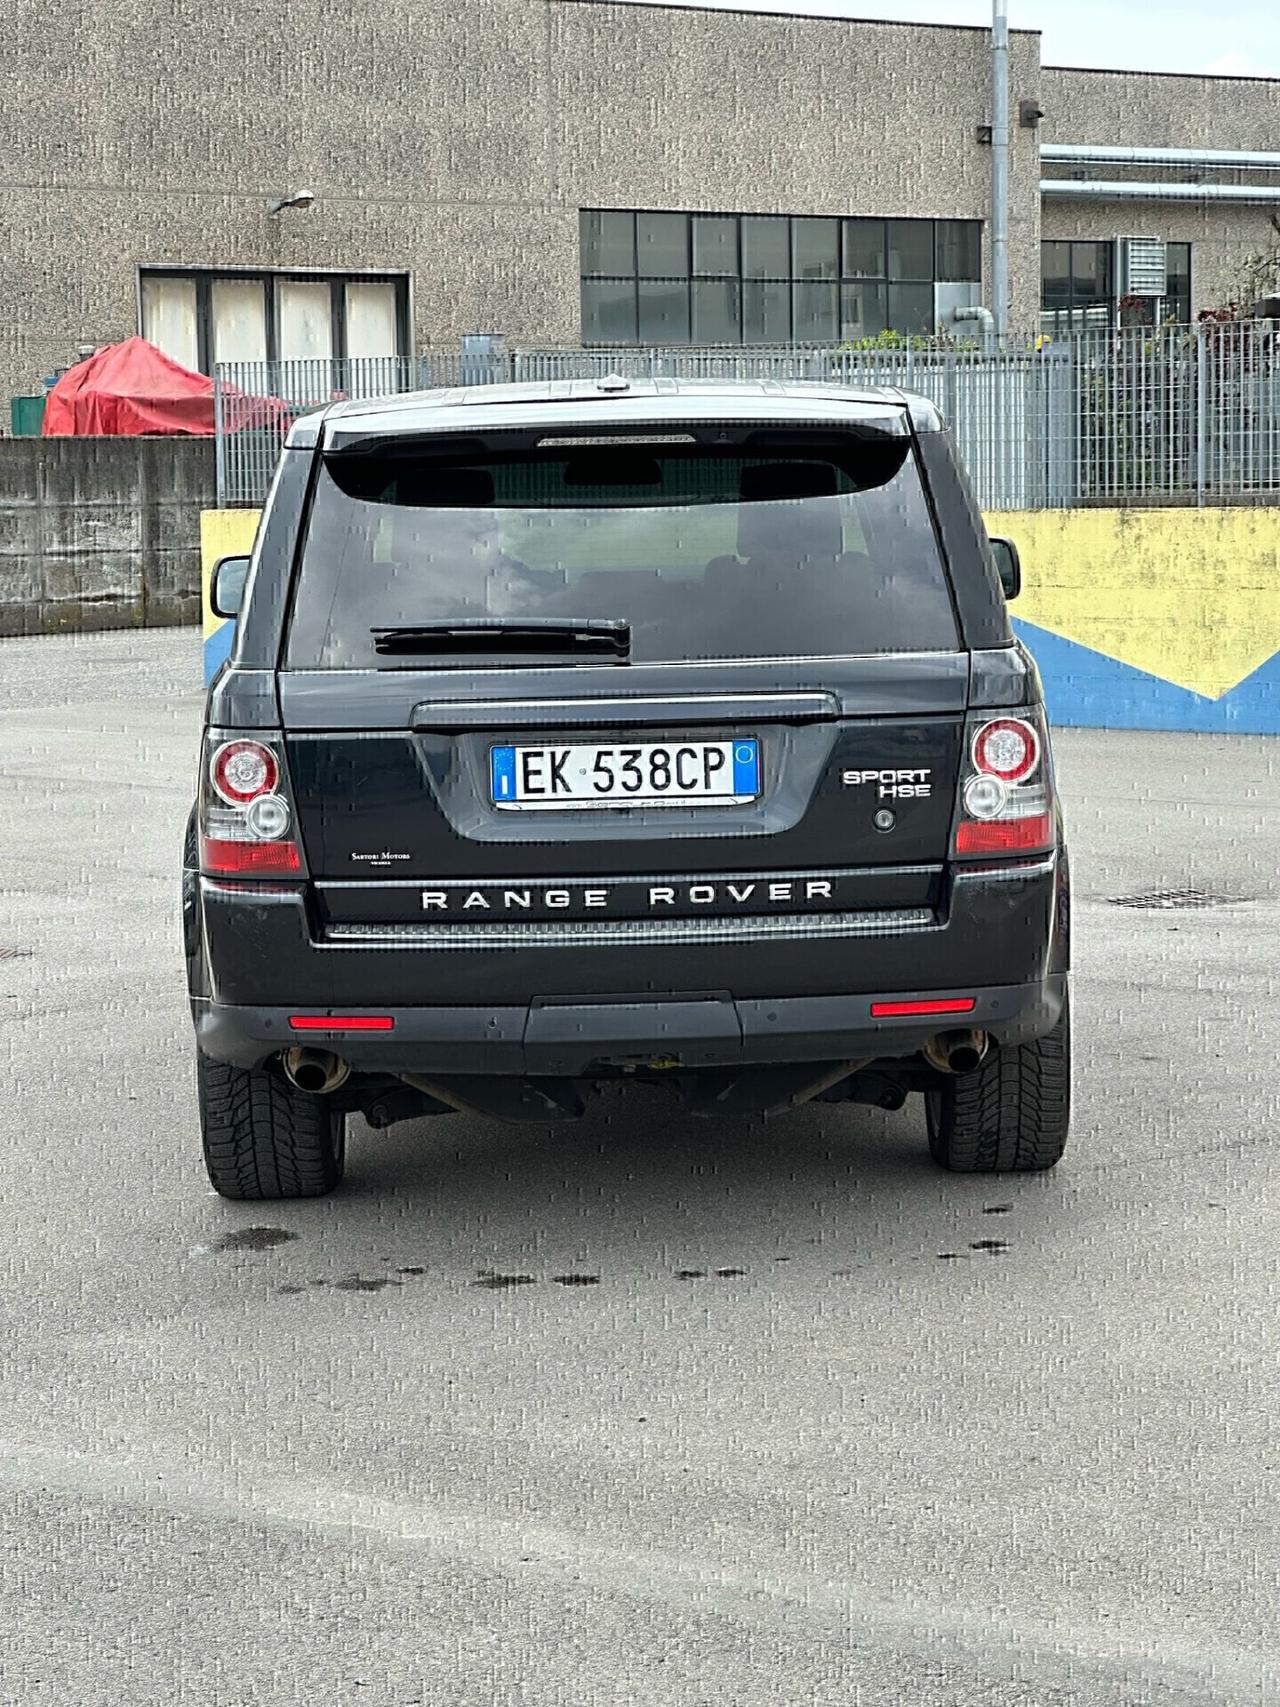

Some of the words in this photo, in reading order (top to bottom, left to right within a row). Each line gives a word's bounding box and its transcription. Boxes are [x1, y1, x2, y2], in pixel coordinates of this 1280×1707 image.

[521, 749, 573, 795] EK
[592, 746, 726, 793] 538CP
[843, 769, 931, 785] SPORT
[879, 784, 931, 798] HSE
[422, 890, 608, 909] RANGE
[649, 881, 832, 905] ROVER
